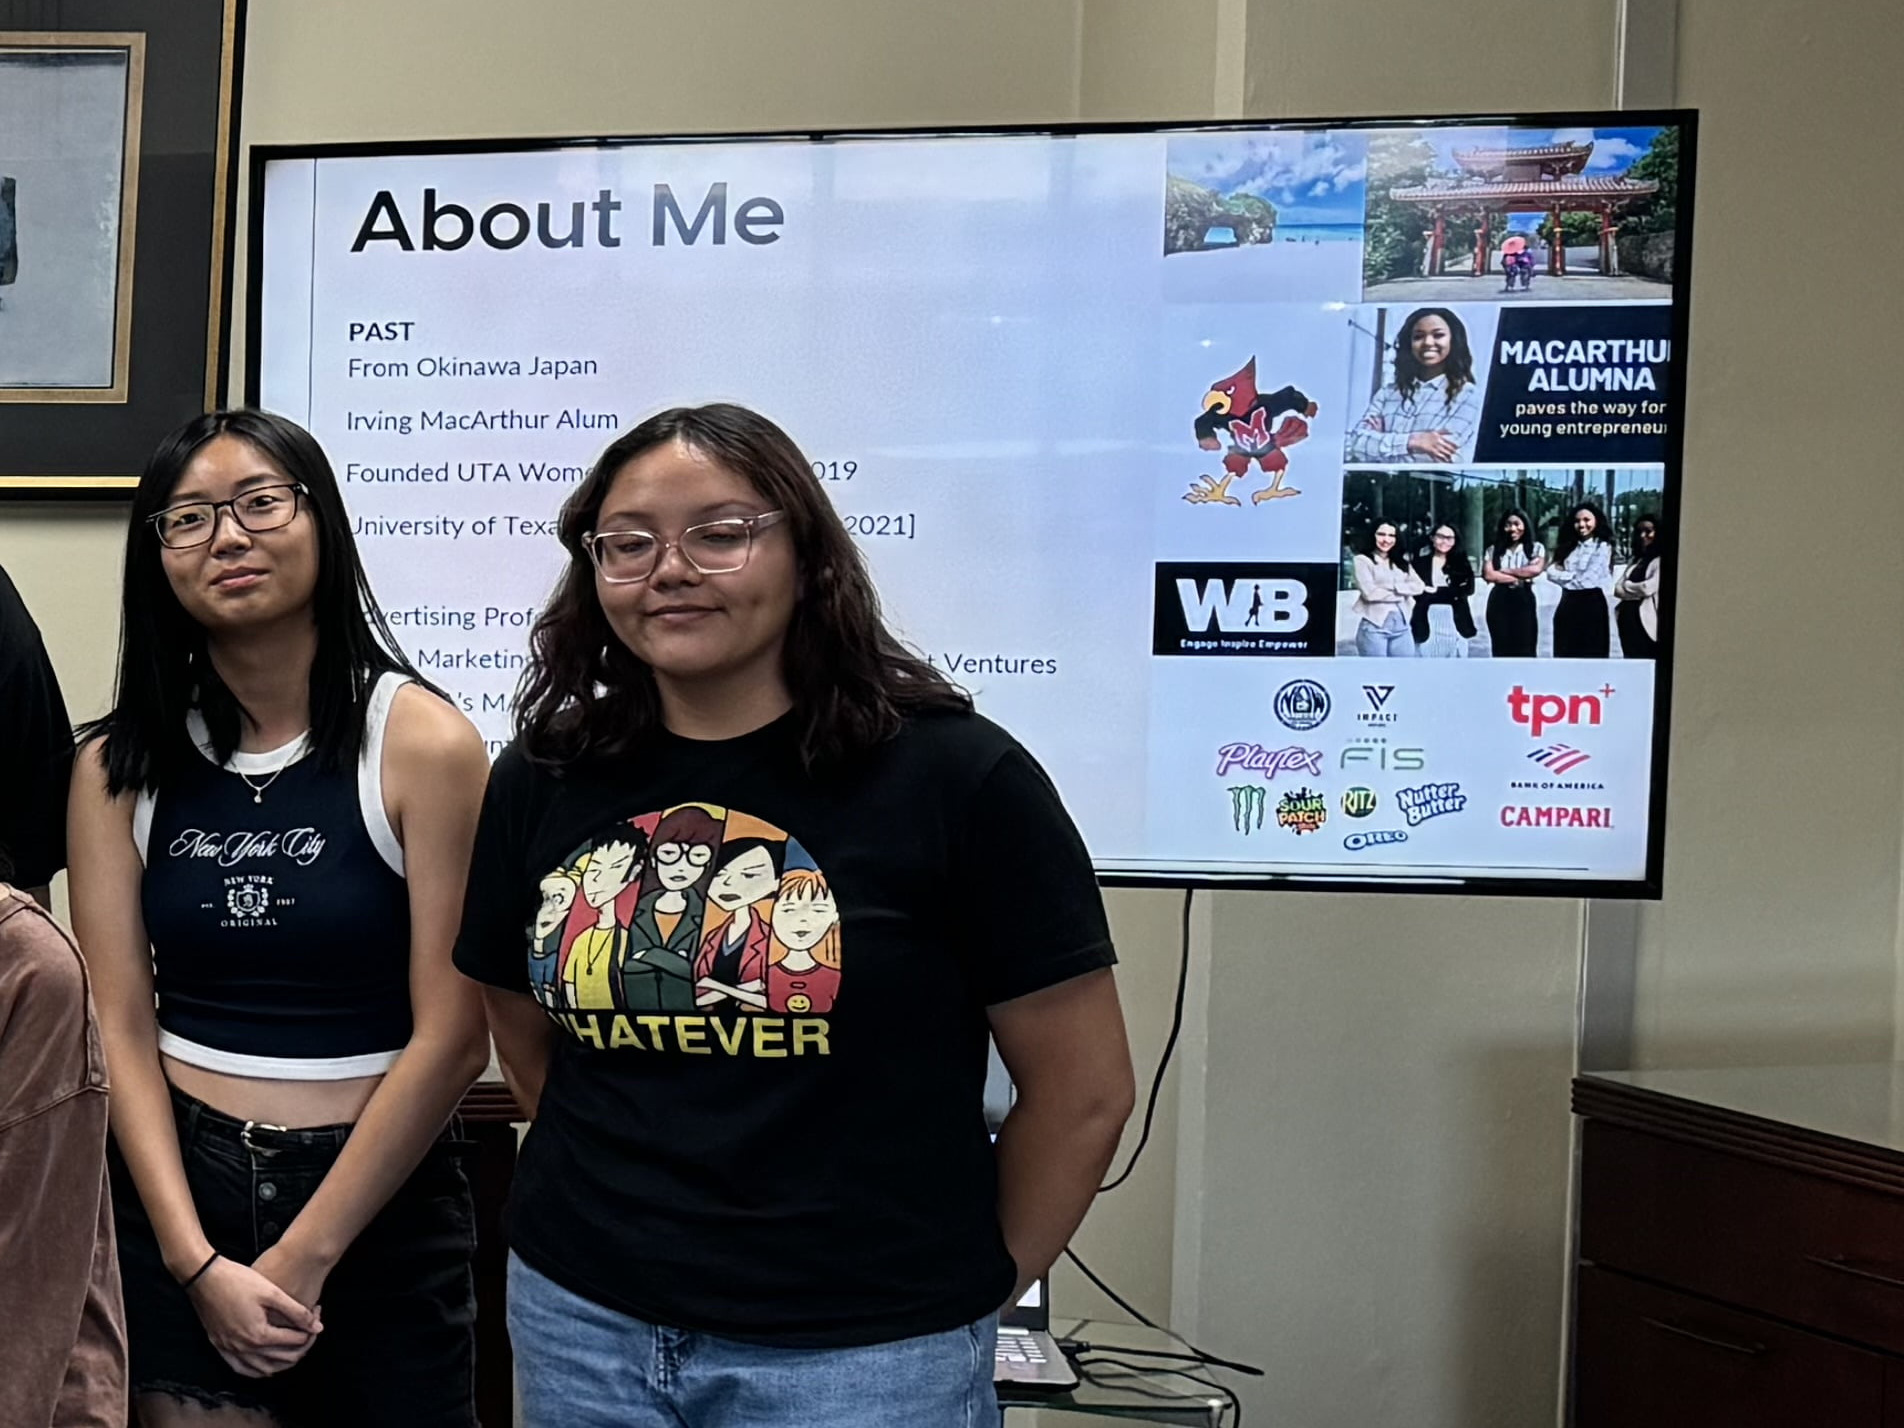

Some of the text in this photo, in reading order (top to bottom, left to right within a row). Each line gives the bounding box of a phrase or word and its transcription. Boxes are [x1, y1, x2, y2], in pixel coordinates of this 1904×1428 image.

[349, 181, 786, 253] About Me
[348, 321, 415, 343] PAST
[1499, 338, 1672, 365] MACARTHU
[348, 356, 598, 380] From Okinawa Japan
[1527, 367, 1656, 392] ALUMNA
[1515, 400, 1667, 418] paves the way for
[347, 408, 619, 435] Irving MacArthur Alum
[1499, 423, 1552, 438] young
[346, 461, 591, 483] Founded UTA Wom
[810, 461, 858, 481] 019
[471, 515, 497, 536] of
[503, 515, 559, 536] Texa
[1180, 638, 1218, 650] Engage
[1221, 638, 1256, 649] Inspire
[417, 648, 529, 669] Marketin
[943, 653, 1057, 674] Ventures
[1216, 742, 1324, 779] Playtex
[1396, 782, 1460, 810] Nutter
[1510, 781, 1538, 789] BANK
[1557, 782, 1605, 790] AMERICA
[1278, 798, 1323, 812] SOUR
[1342, 790, 1376, 814] RITZ
[1405, 795, 1467, 826] Butter
[1276, 810, 1327, 824] PATCH
[1500, 805, 1611, 828] CAMPARI
[168, 827, 326, 867] New York City
